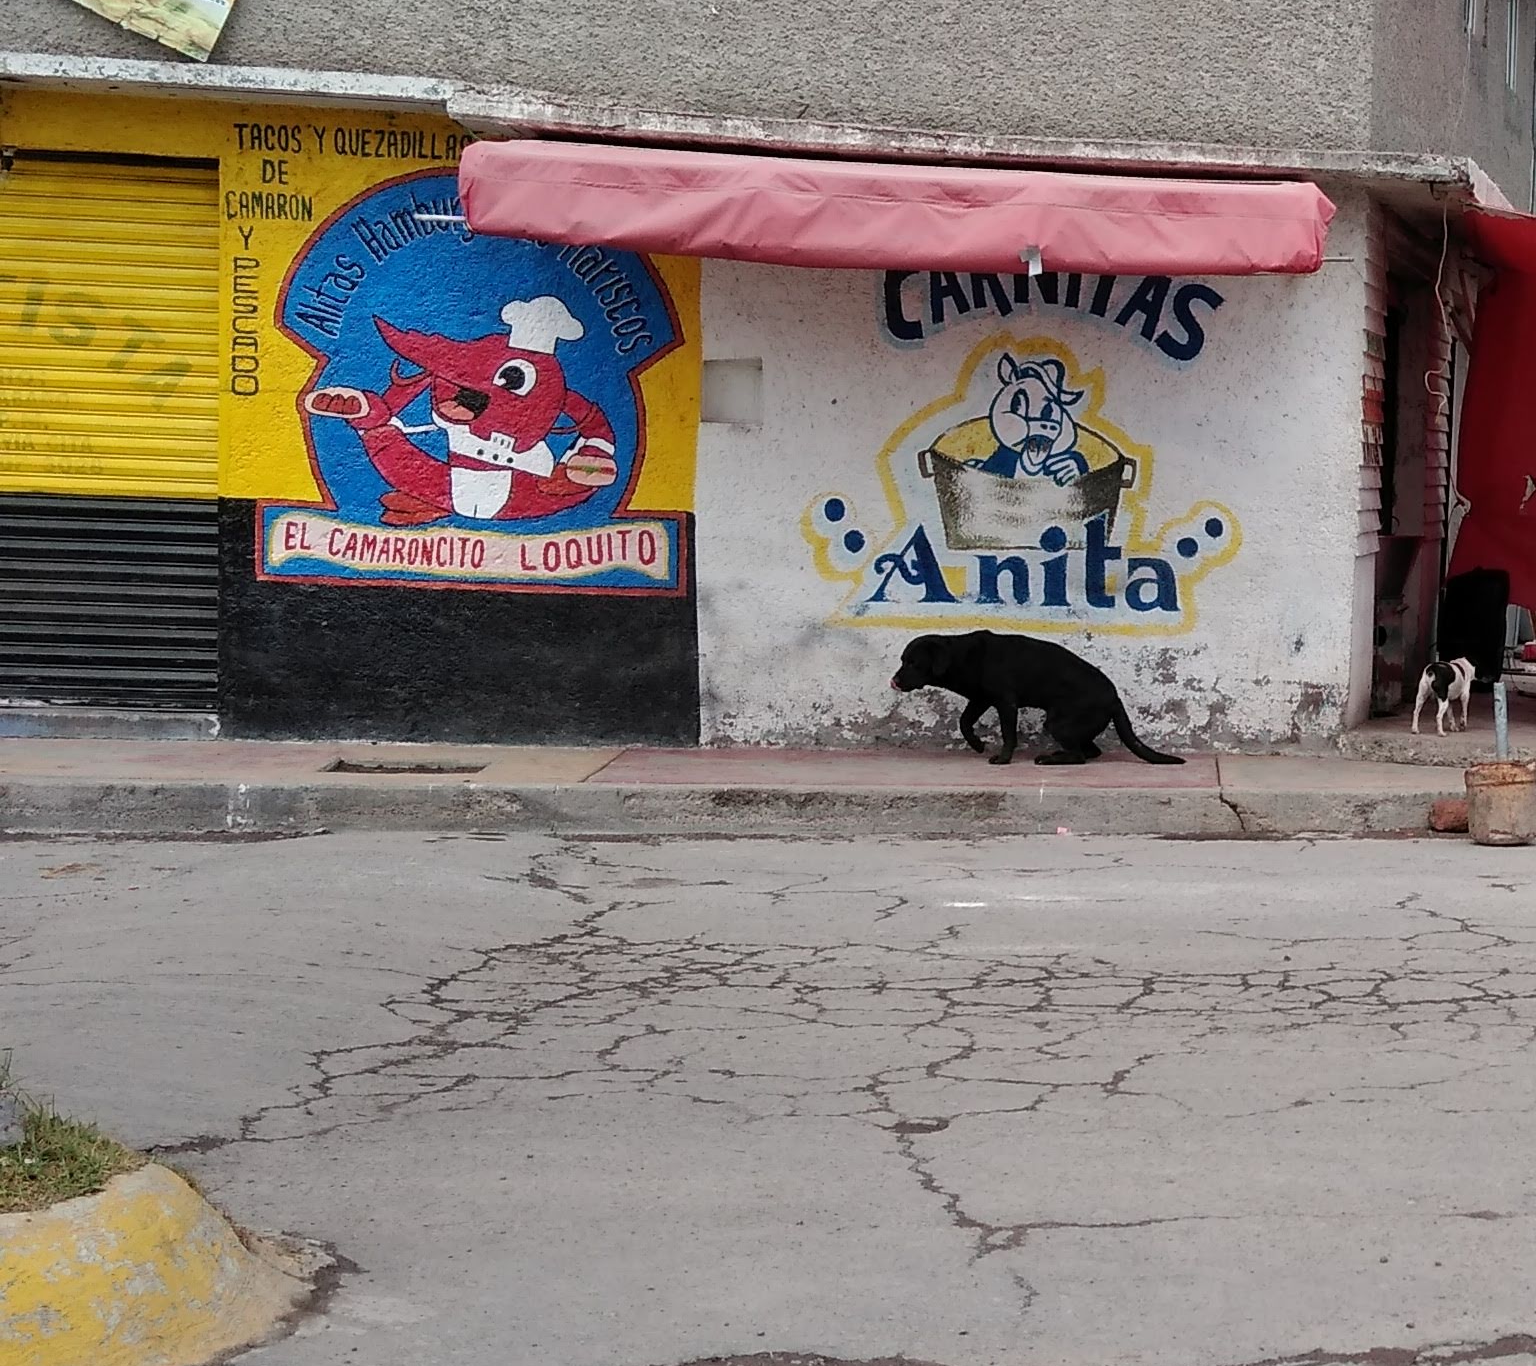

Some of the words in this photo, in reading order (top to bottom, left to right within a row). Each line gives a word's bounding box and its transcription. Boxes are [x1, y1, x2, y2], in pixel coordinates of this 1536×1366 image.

[234, 123, 302, 154] TACOS
[312, 125, 327, 149] Y
[261, 158, 290, 185] DE
[224, 190, 314, 222] CAMARON
[238, 225, 254, 251] Y
[294, 252, 367, 340] Alitas
[284, 521, 312, 551] EL
[327, 526, 486, 570] CAMARONCITO
[519, 529, 658, 574] LOQUITO
[865, 509, 1182, 614] Anita
